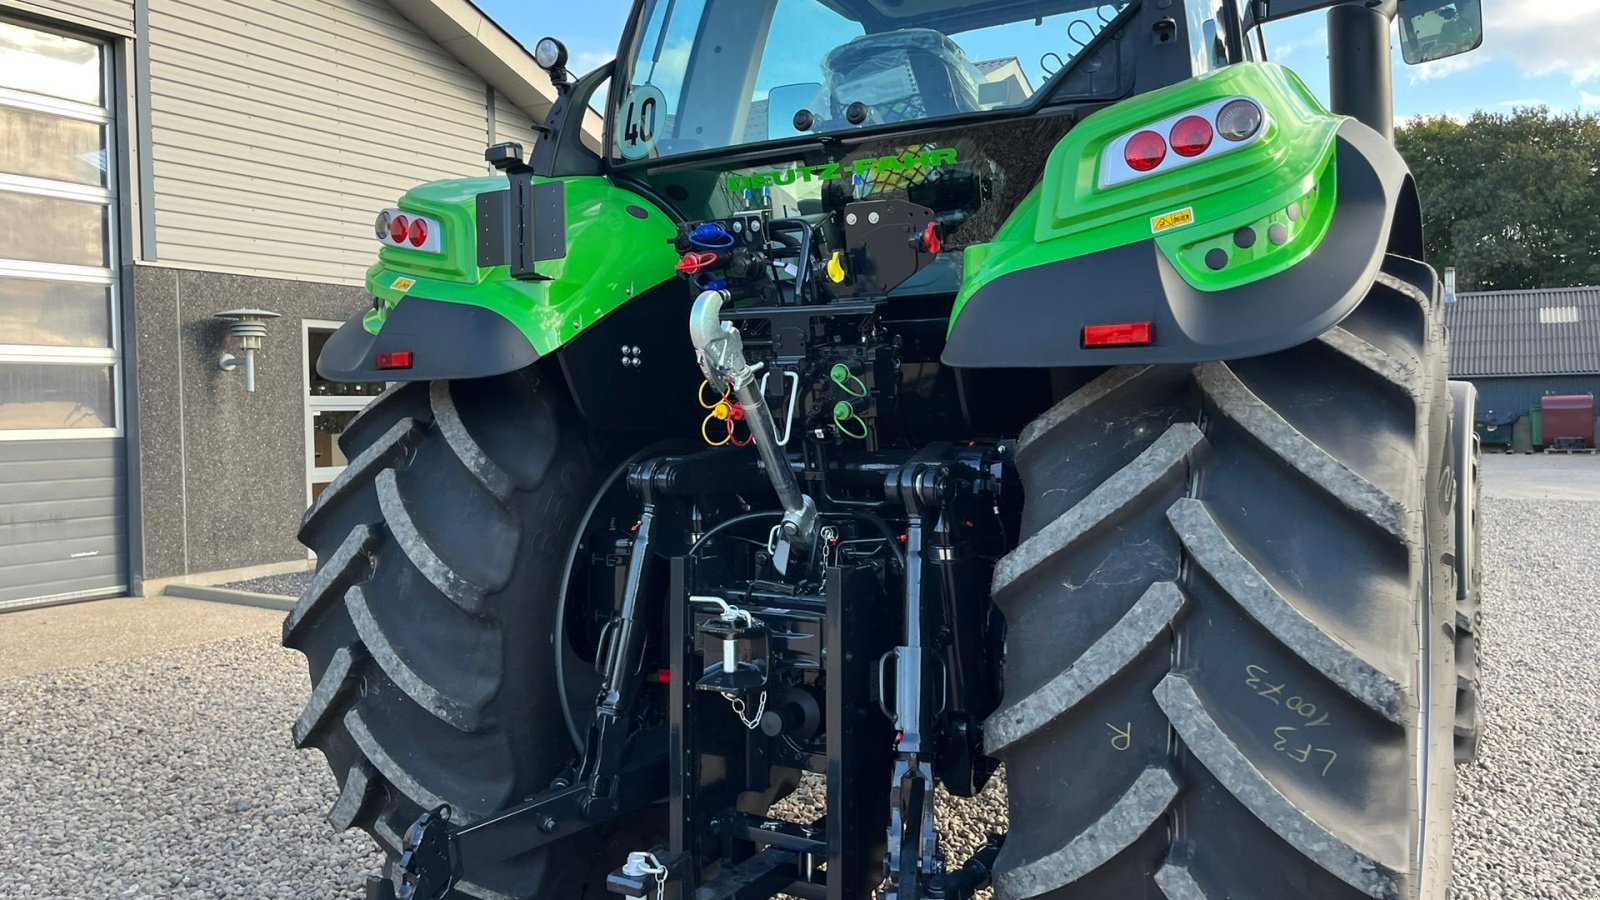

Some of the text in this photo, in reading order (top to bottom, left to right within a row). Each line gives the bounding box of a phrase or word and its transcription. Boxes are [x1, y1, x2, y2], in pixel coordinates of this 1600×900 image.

[625, 97, 656, 146] 40
[726, 147, 958, 191] DEUTZ-FAHR
[1105, 721, 1131, 750] R
[1272, 726, 1337, 777] LF3
